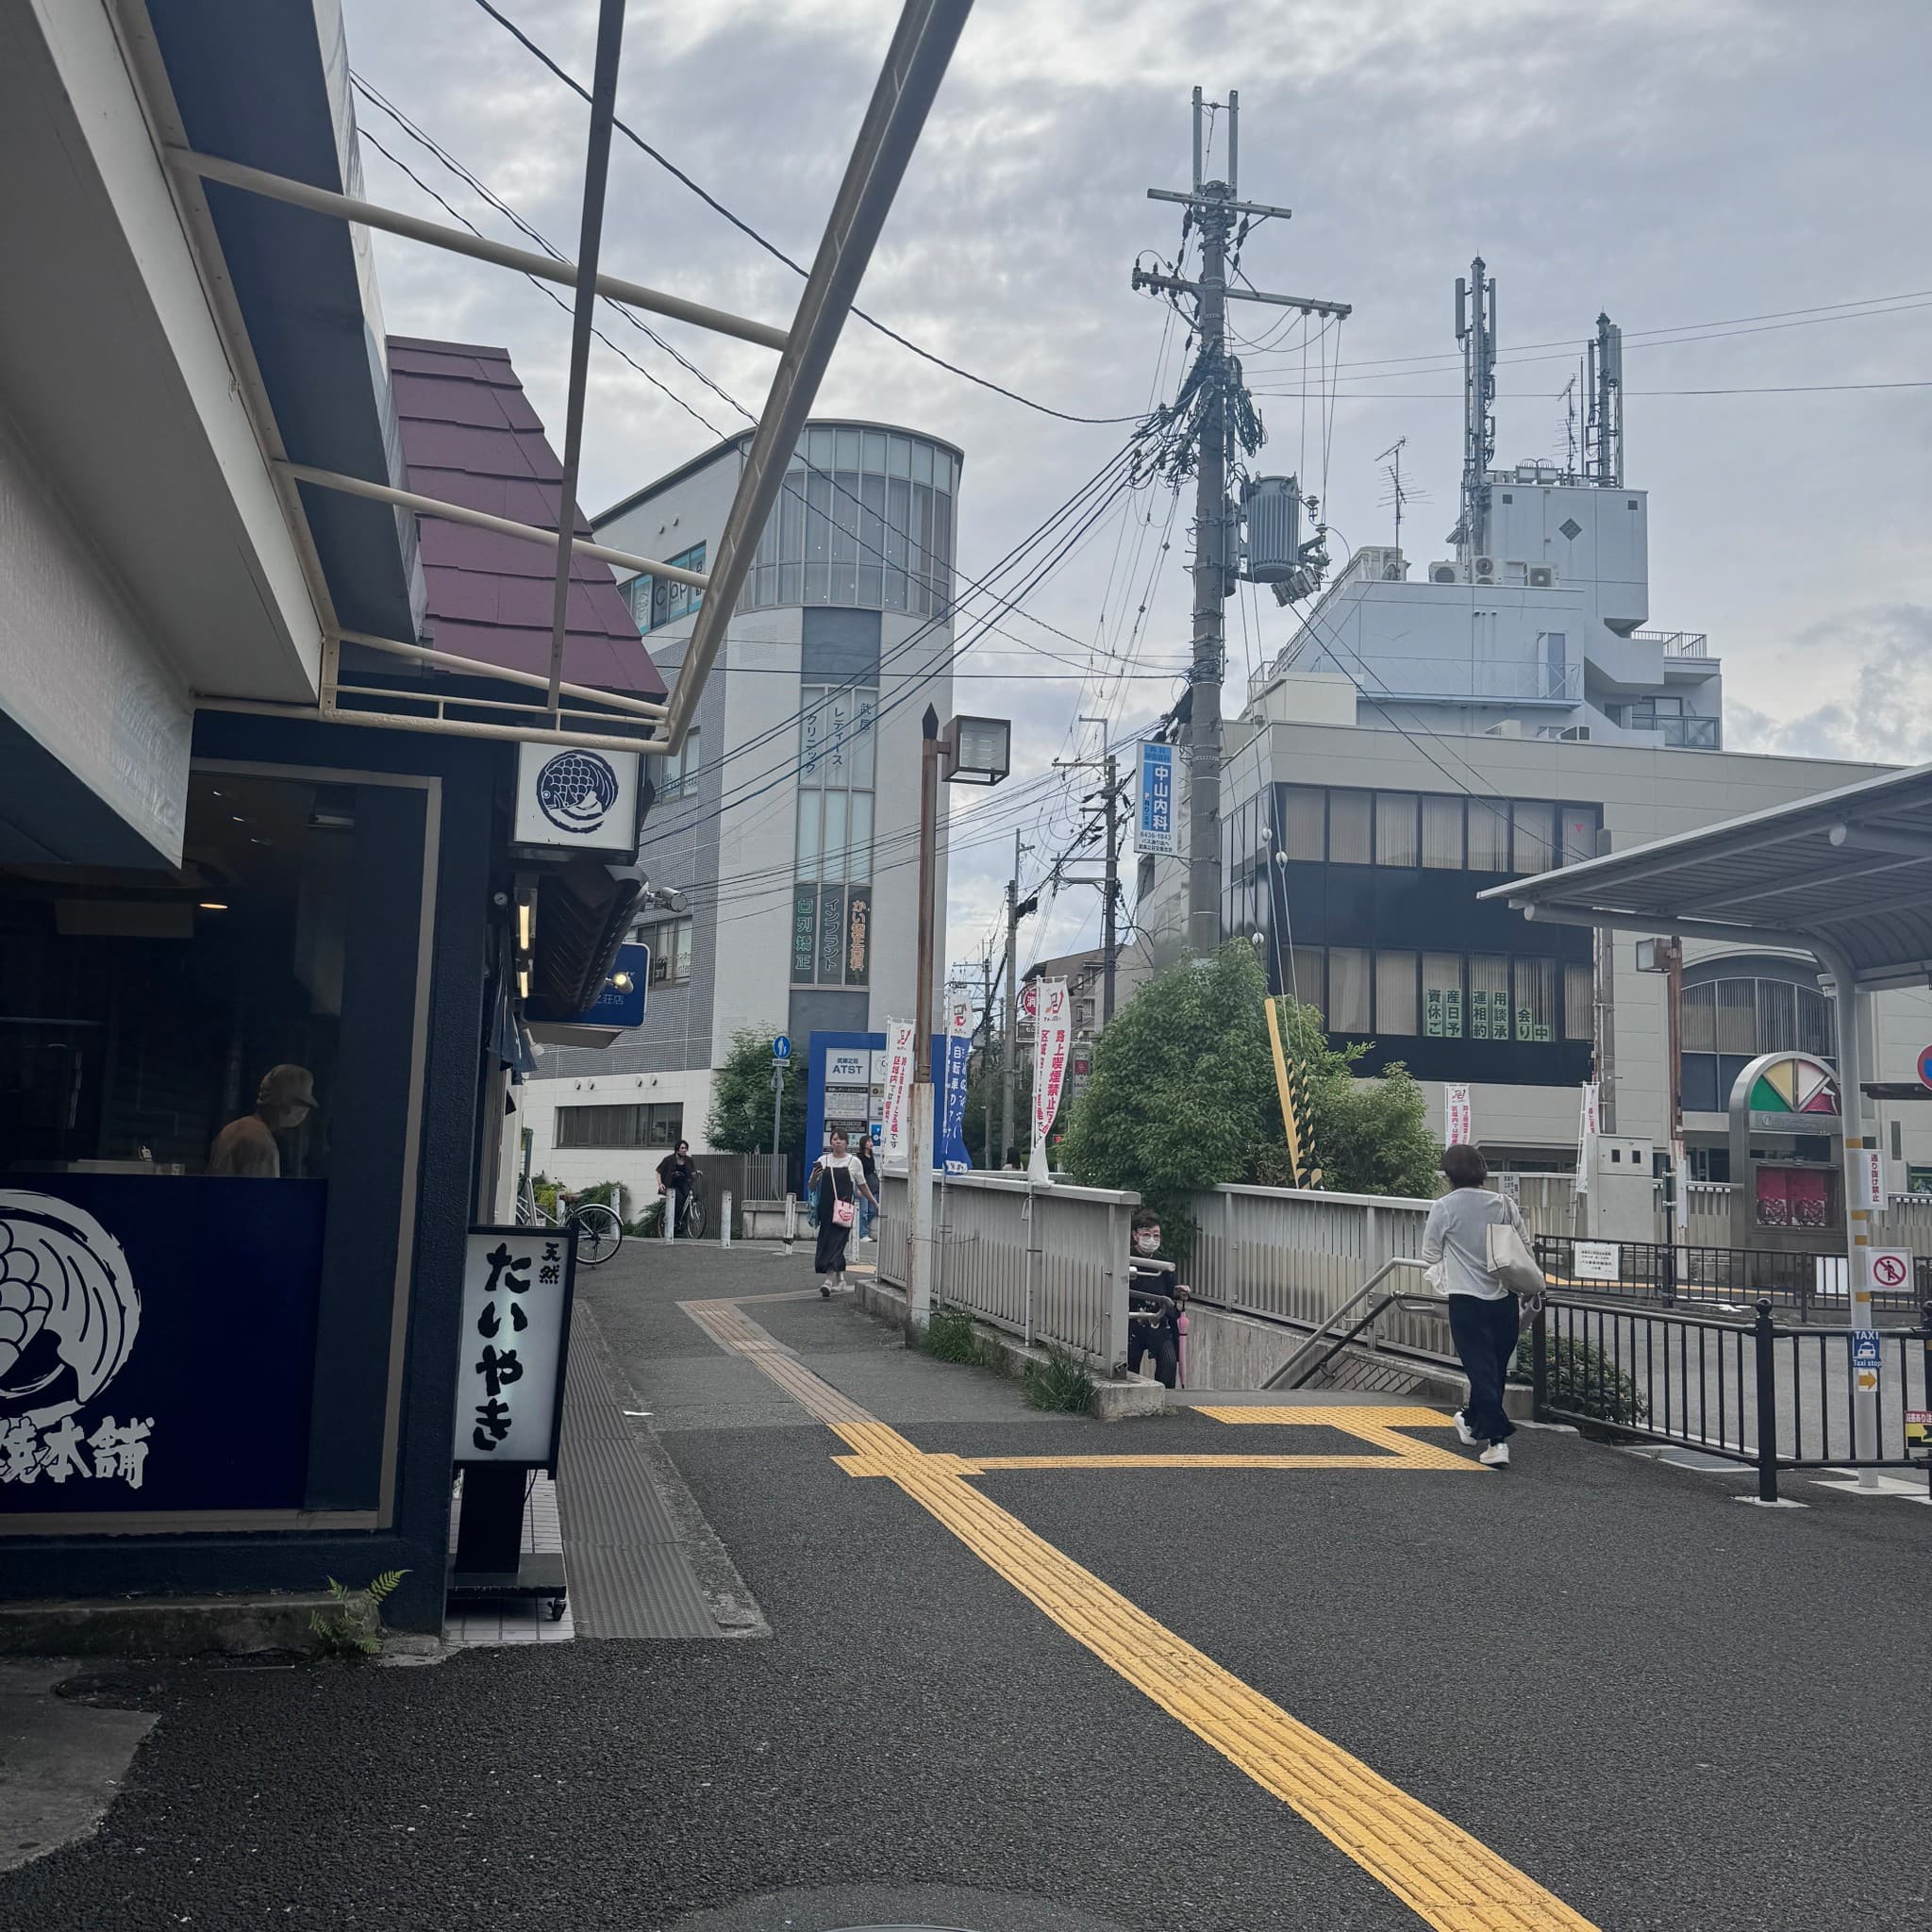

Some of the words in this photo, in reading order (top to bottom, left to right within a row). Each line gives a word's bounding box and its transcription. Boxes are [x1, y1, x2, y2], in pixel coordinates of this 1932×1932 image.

[806, 715, 817, 774] クリニック
[832, 707, 844, 765] レディース
[1153, 765, 1169, 831] 中山内科
[795, 898, 814, 970] 歯列矯正
[824, 898, 840, 971] インプラント
[1428, 990, 1507, 1007] 資産運用
[1428, 1007, 1531, 1024] 休日相談会
[1429, 1022, 1548, 1041] ご予約承り中
[832, 1065, 863, 1074] ATST
[1871, 1154, 1880, 1203] 通り抜け禁止
[540, 1241, 560, 1285] 天然
[473, 1242, 531, 1451] たいやき
[1855, 1330, 1879, 1340] TAXI
[1867, 1359, 1881, 1369] stop
